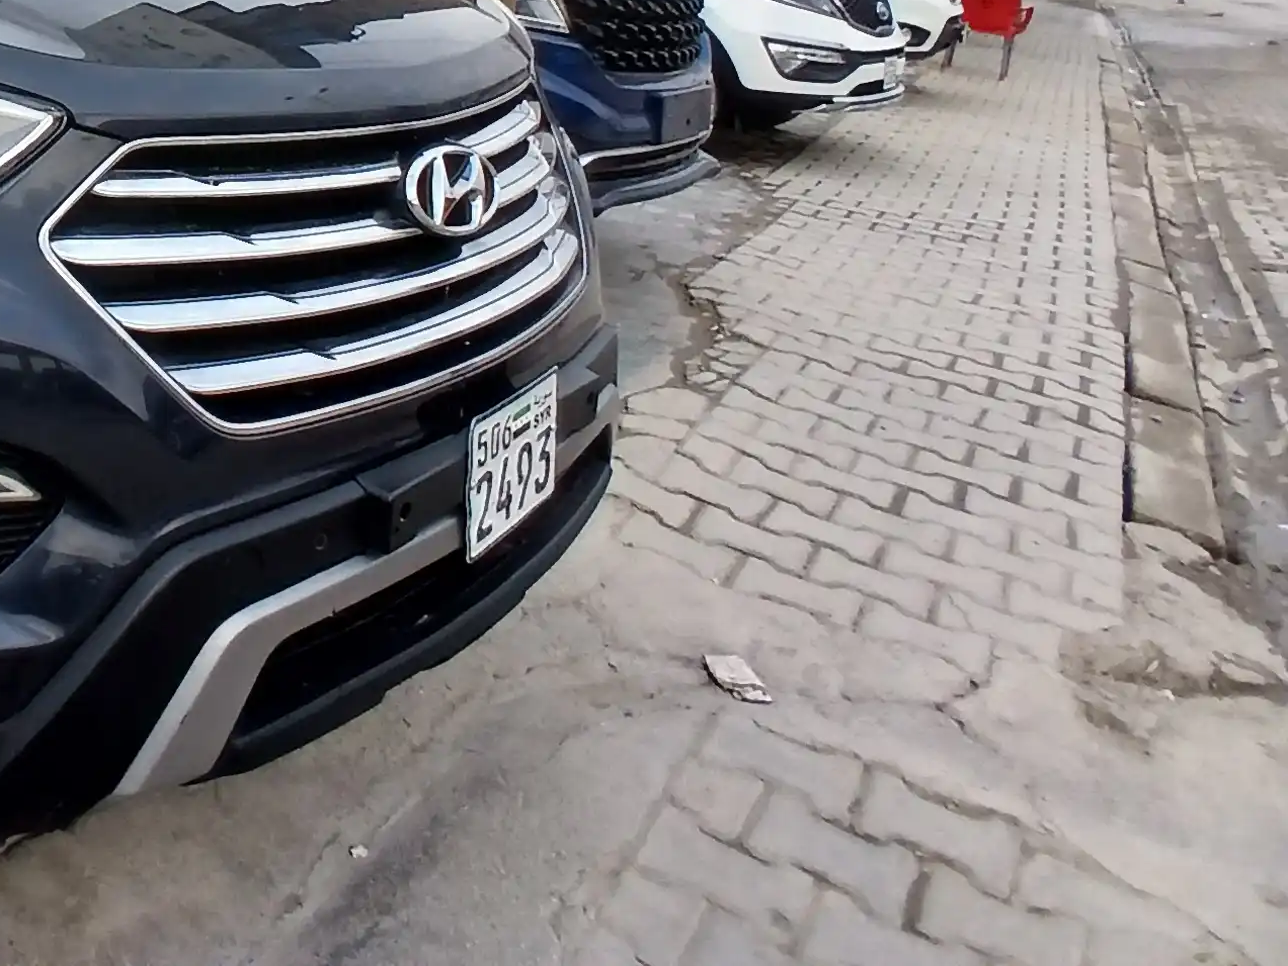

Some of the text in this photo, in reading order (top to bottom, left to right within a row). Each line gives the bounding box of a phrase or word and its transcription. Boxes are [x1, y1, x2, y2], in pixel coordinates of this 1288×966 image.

[477, 414, 512, 468] 506
[533, 404, 552, 430] SYR
[476, 425, 553, 543] 2493
